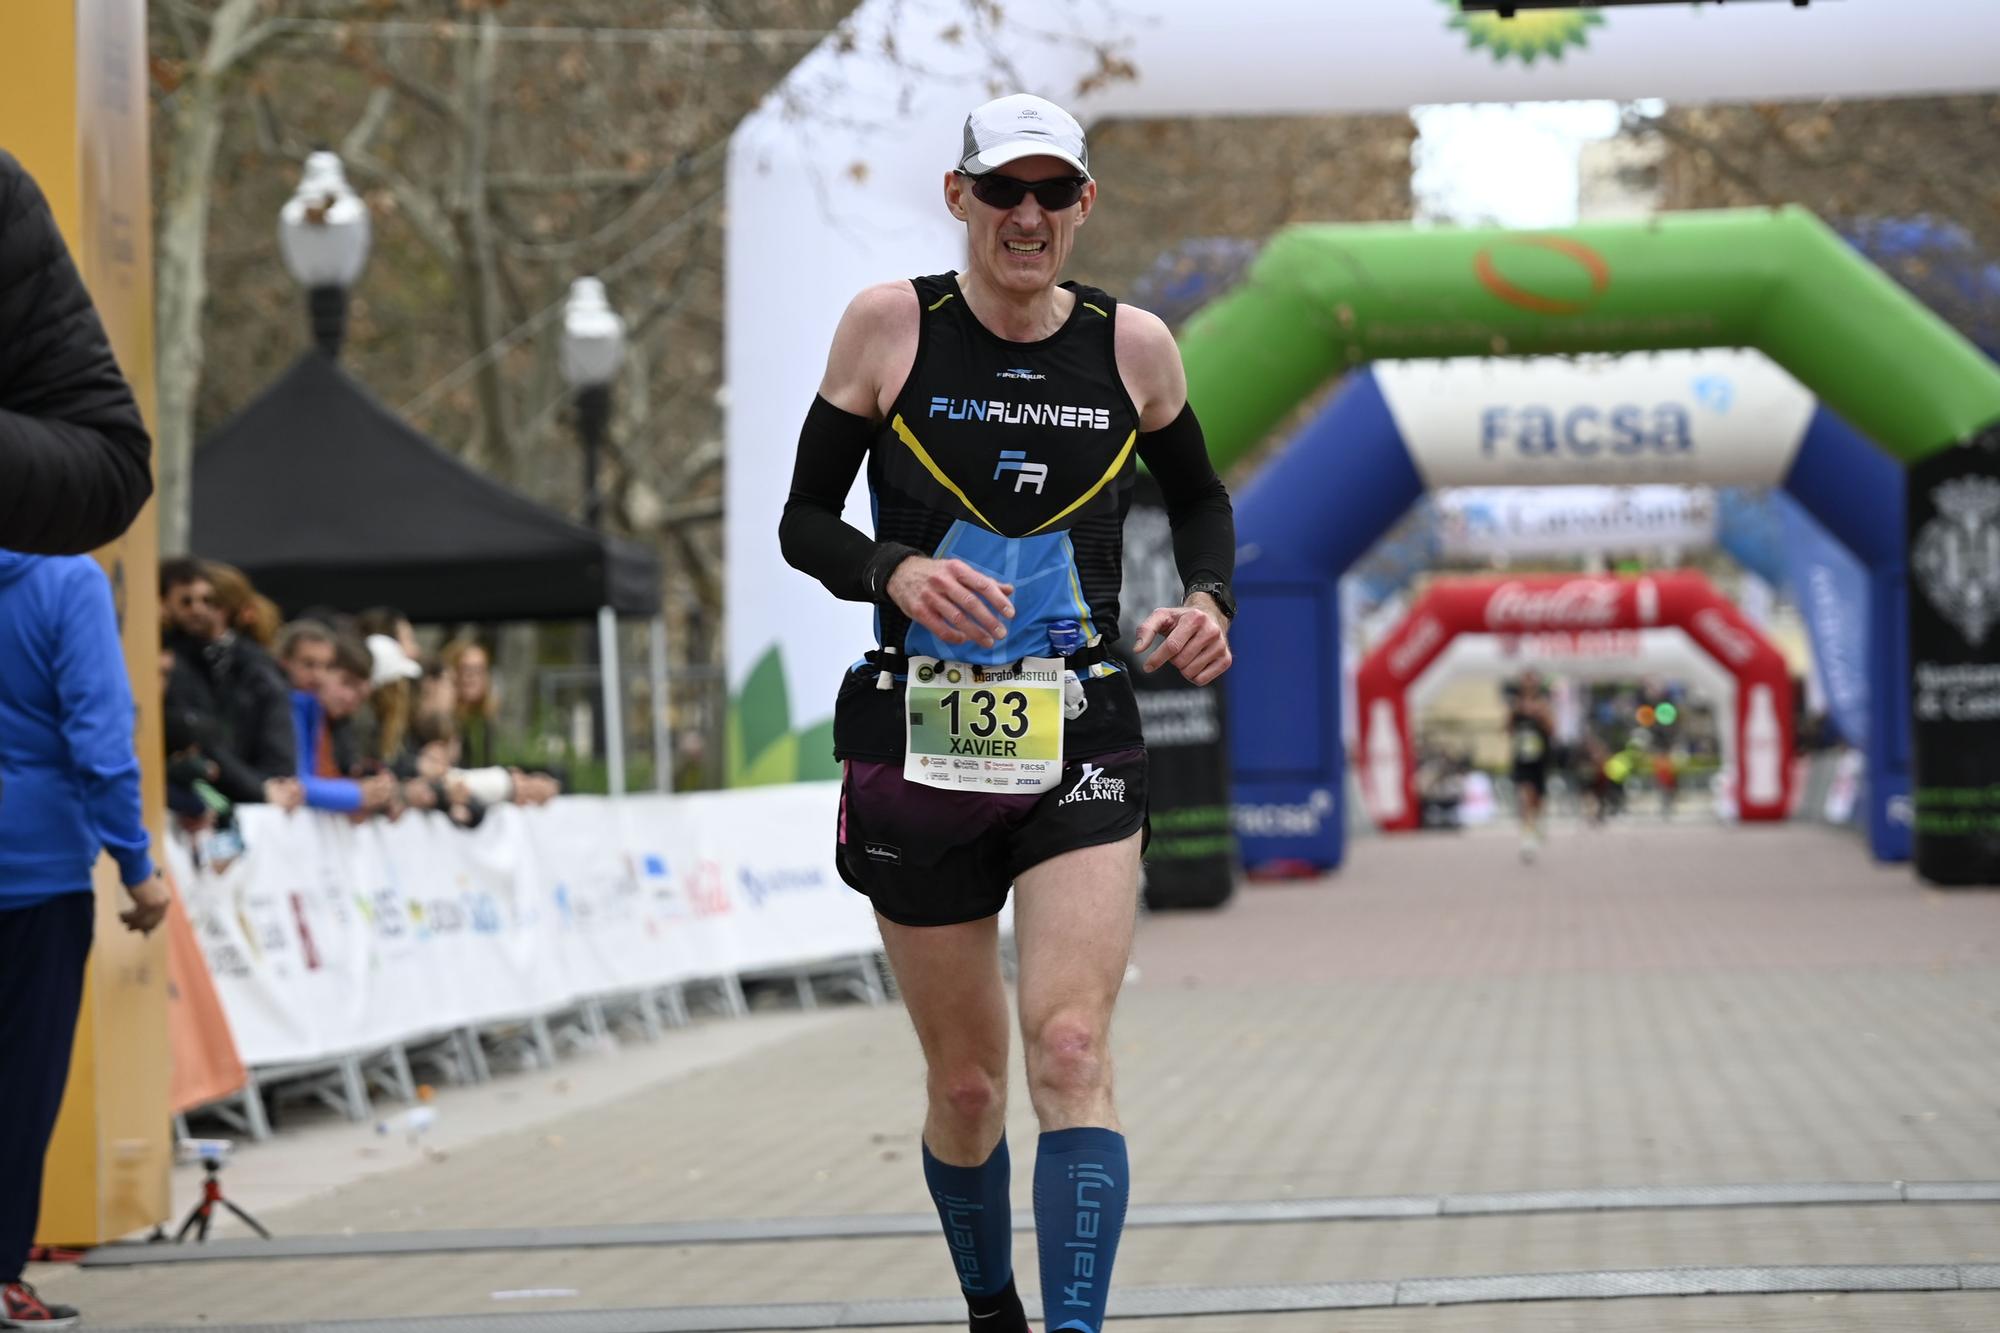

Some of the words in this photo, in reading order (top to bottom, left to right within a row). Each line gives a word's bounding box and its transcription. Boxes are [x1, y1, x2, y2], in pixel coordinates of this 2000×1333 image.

[929, 397, 1110, 430] FUNRUNNERS
[940, 690, 1029, 738] 133
[950, 738, 1017, 757] XAVIER
[1058, 789, 1125, 807] ADELANTE
